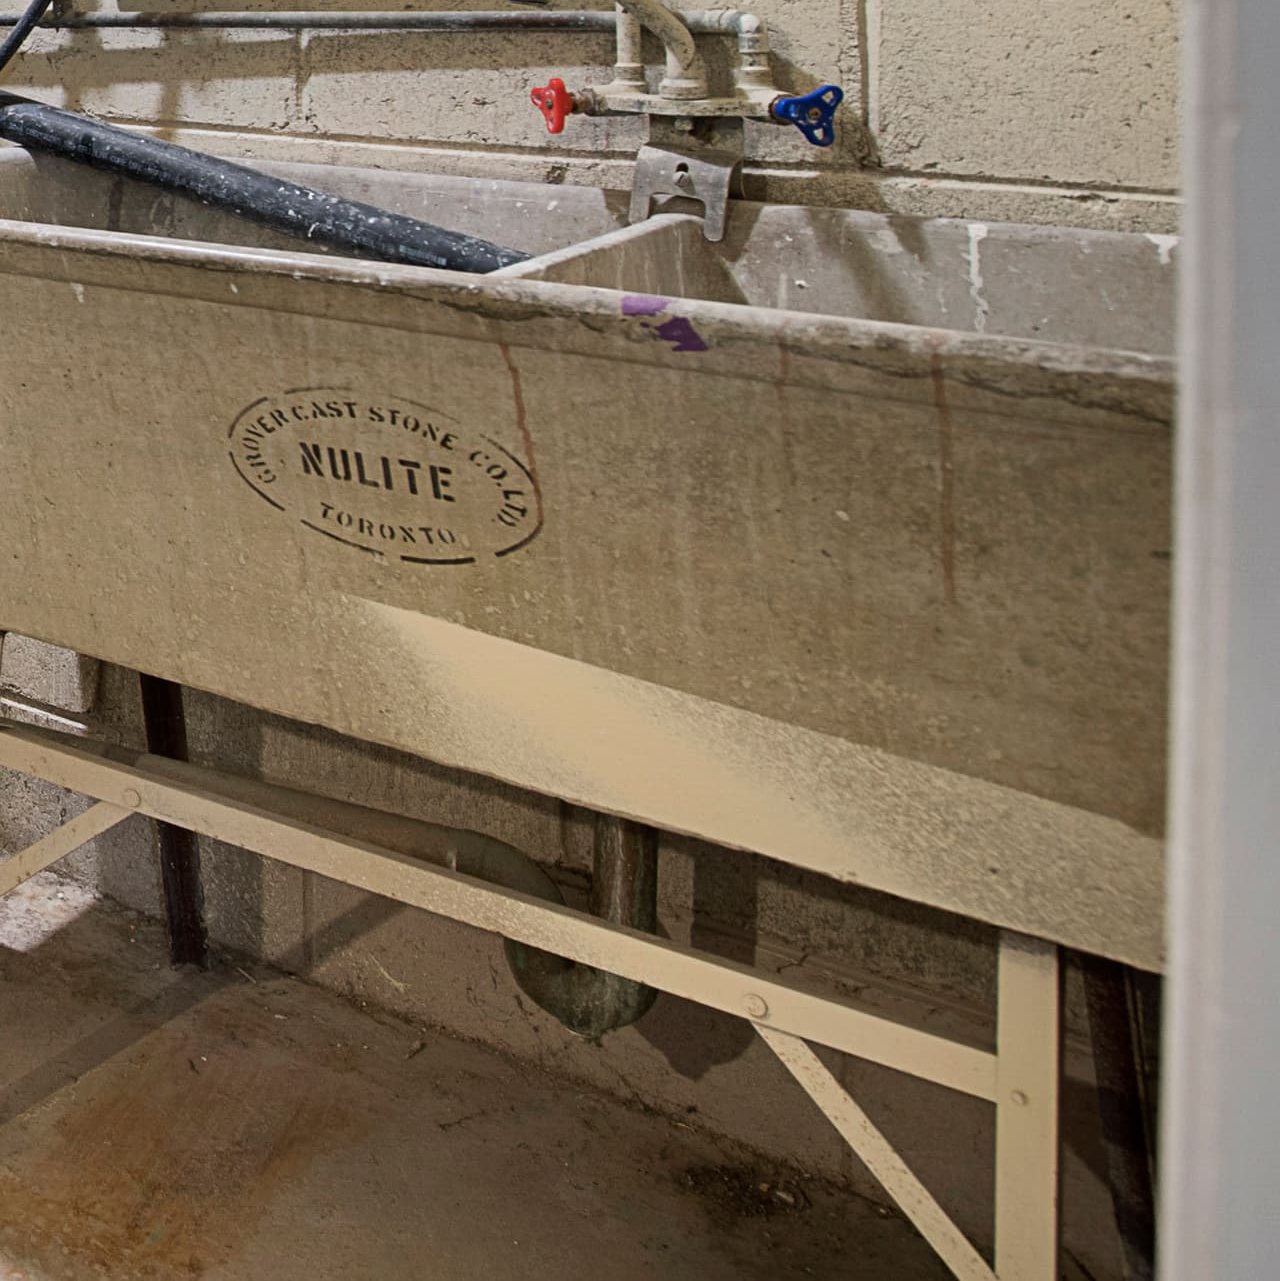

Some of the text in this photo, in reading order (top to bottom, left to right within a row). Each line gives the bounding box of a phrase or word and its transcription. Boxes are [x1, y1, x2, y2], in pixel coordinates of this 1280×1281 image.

[368, 406, 459, 450] STONE
[299, 441, 456, 503] NULITE
[320, 502, 457, 546] TORONTO
